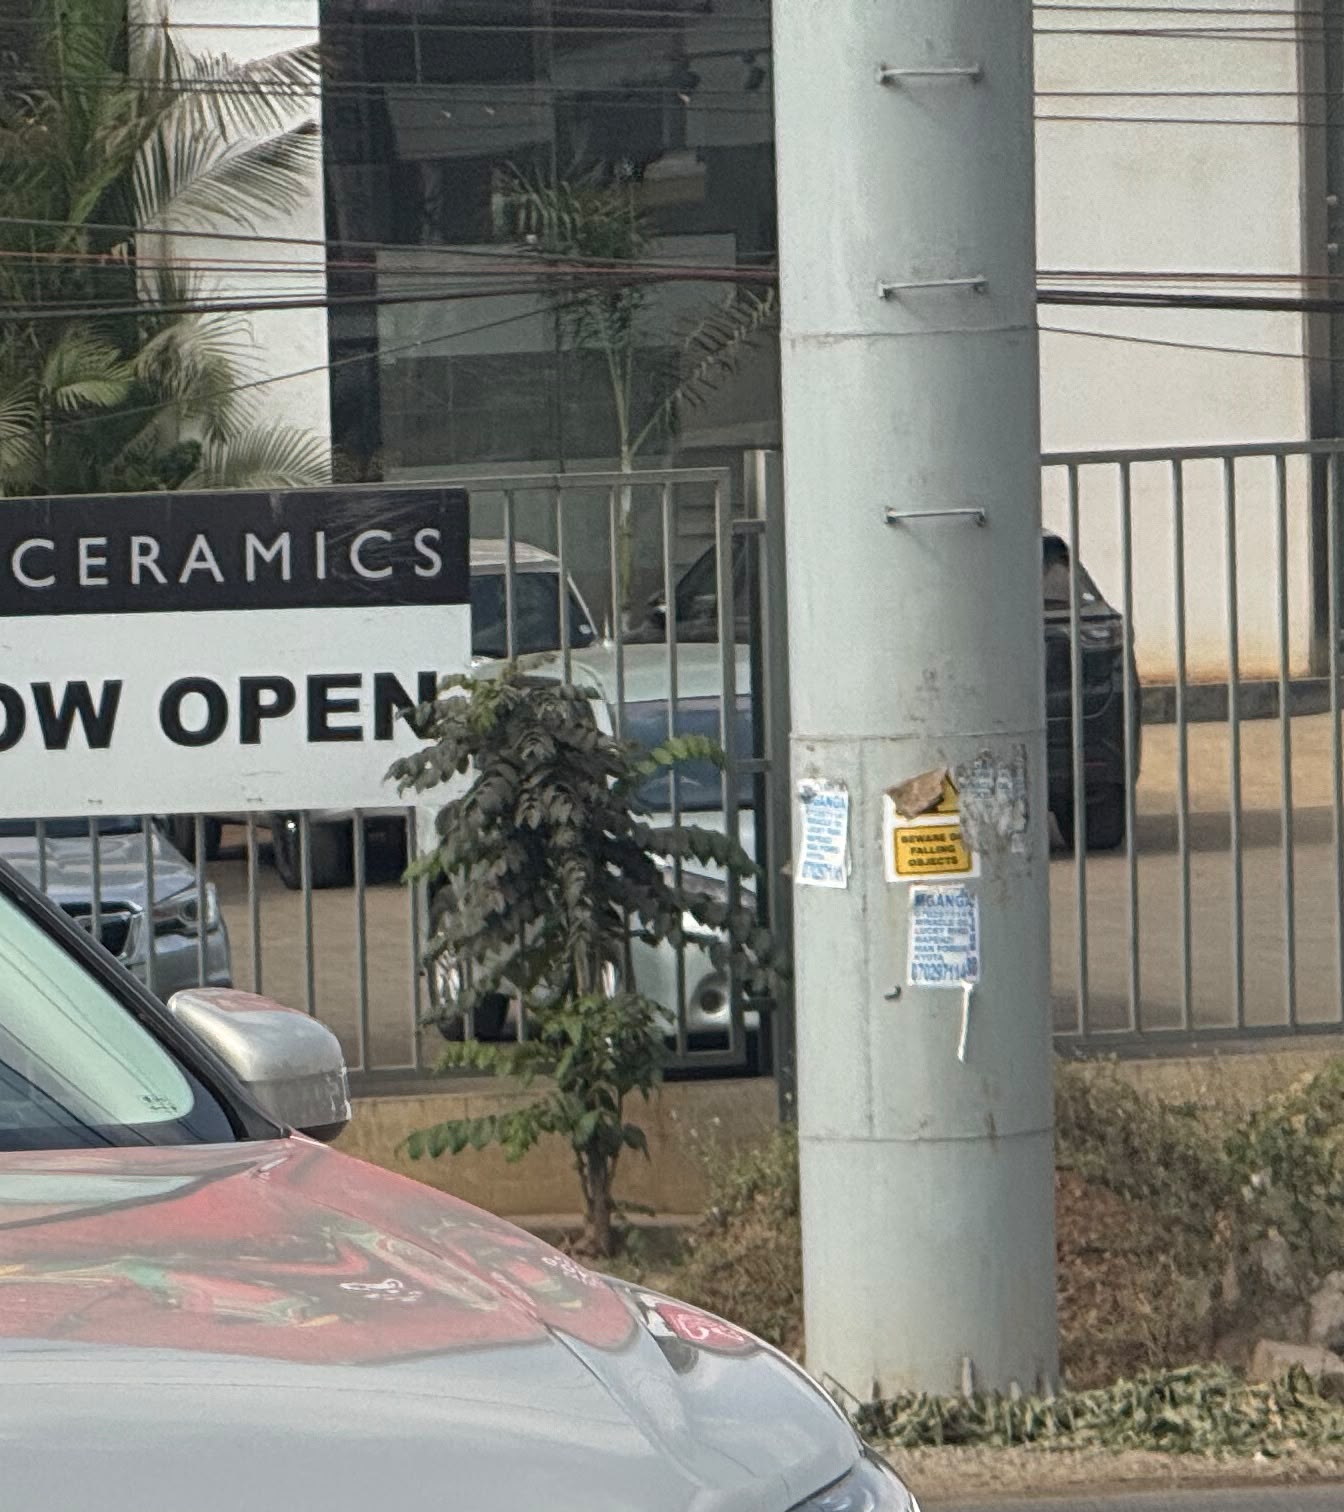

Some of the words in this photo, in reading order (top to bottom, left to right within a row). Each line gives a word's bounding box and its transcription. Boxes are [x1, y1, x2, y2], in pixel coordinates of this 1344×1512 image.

[12, 528, 443, 588] CERAMICS
[159, 671, 439, 747] OPEN
[900, 832, 946, 843] BEWARE
[910, 844, 956, 855] FALLING
[907, 856, 959, 866] OBJECTS
